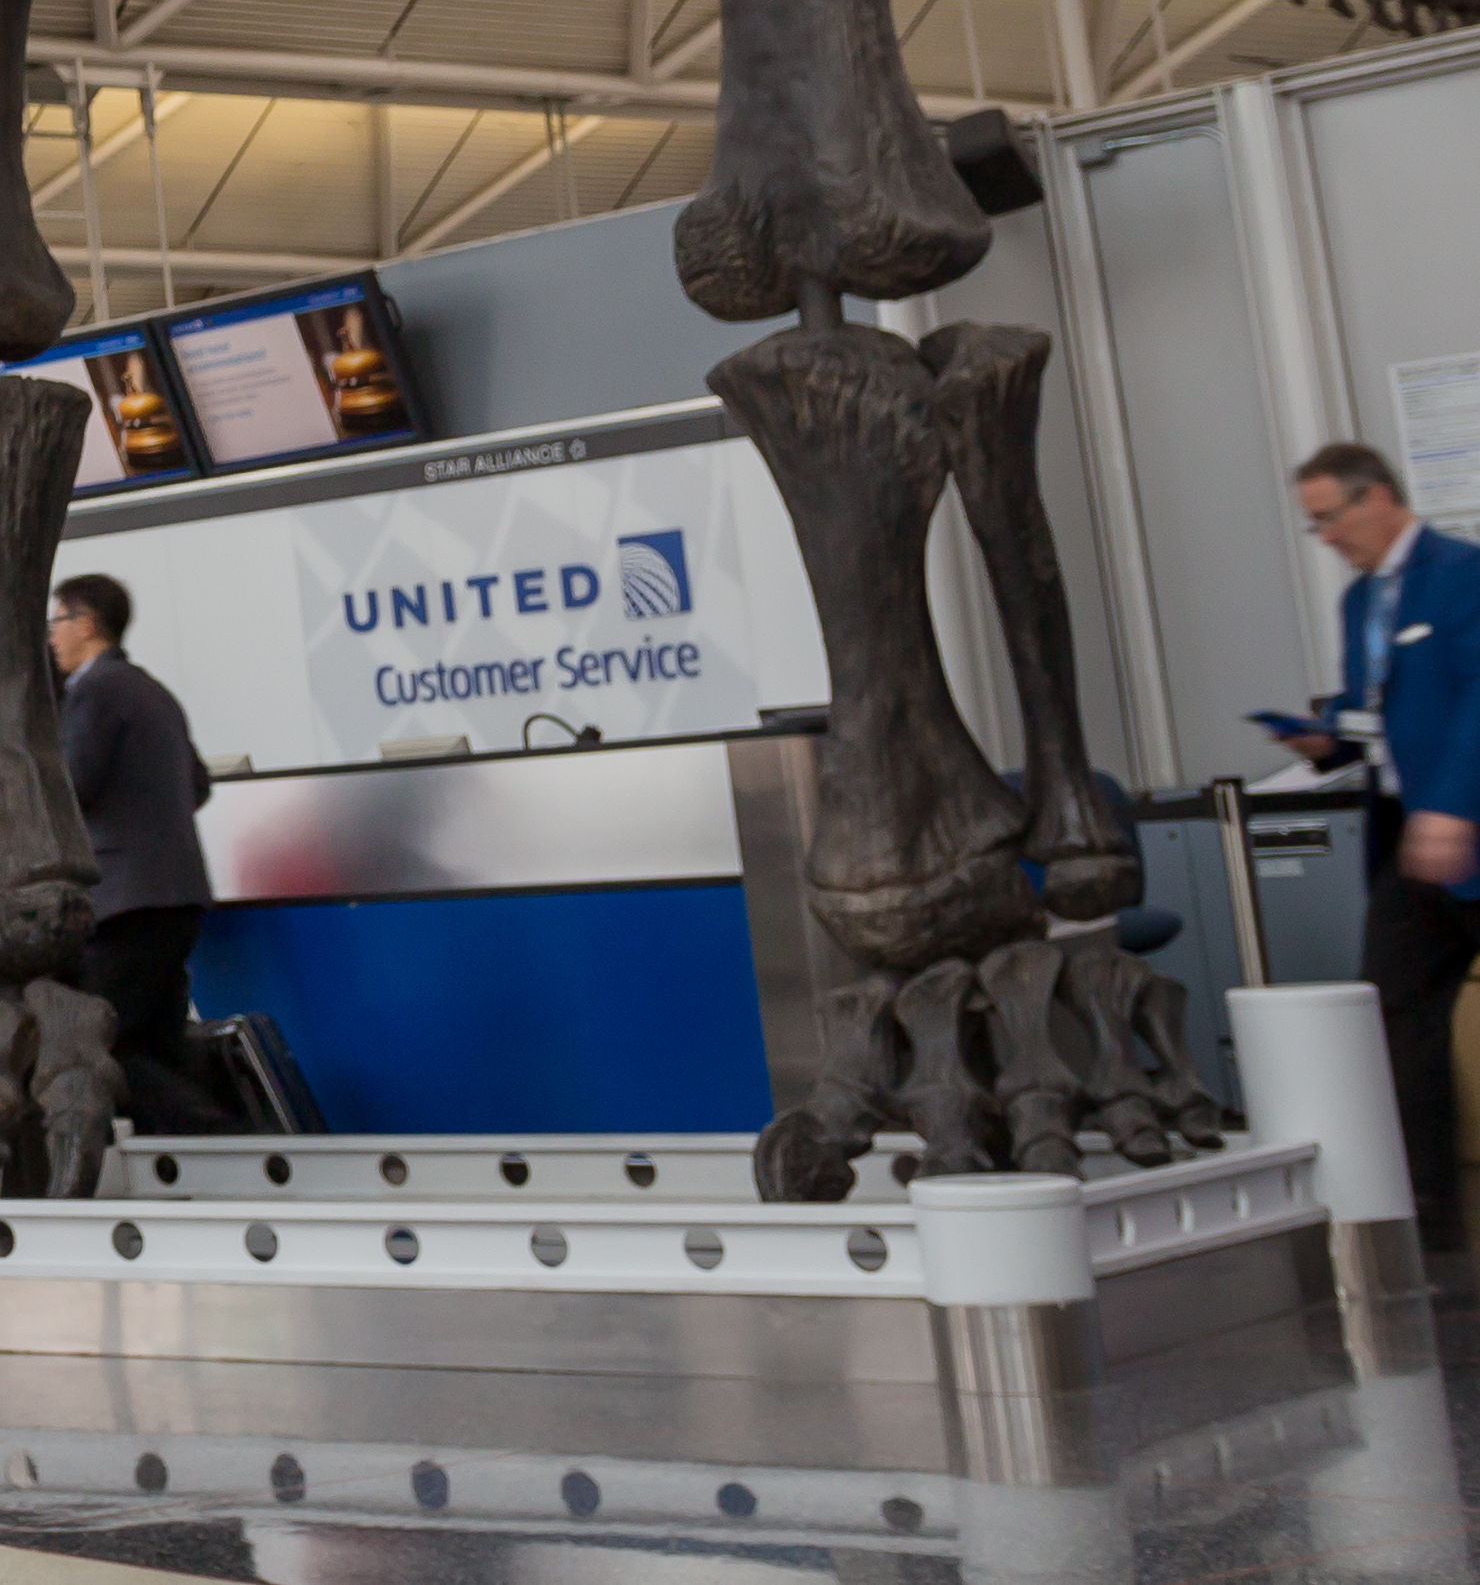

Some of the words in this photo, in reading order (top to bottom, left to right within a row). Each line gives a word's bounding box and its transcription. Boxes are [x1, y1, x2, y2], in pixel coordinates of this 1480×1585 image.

[424, 455, 472, 483] STAR
[474, 441, 564, 475] ALLIANCE
[344, 564, 600, 632] UNITED
[376, 657, 546, 707] Customer
[556, 635, 700, 689] Service
